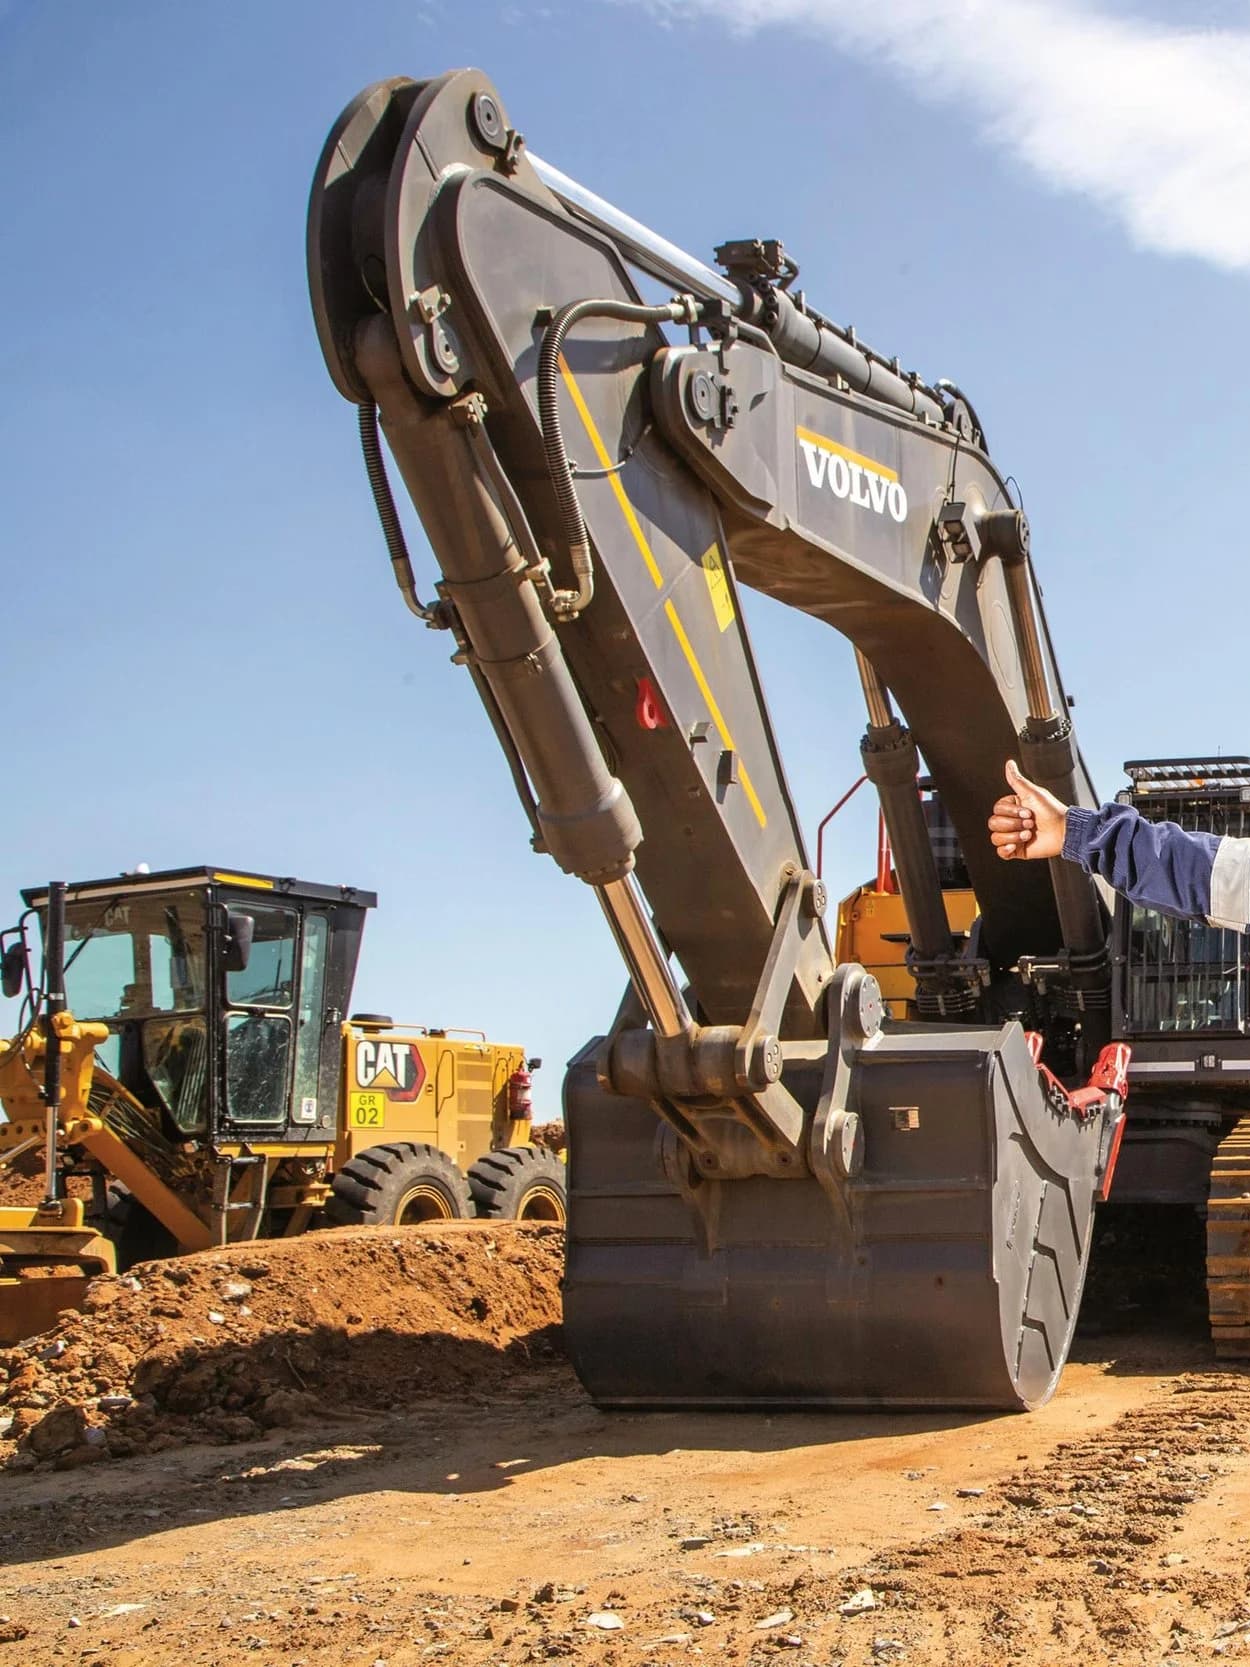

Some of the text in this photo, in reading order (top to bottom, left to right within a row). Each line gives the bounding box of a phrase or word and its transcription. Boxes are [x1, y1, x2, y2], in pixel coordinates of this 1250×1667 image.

[799, 438, 908, 523] VOLVO
[357, 1041, 410, 1088] CAT
[356, 1107, 378, 1125] 02
[359, 1095, 376, 1106] GR
